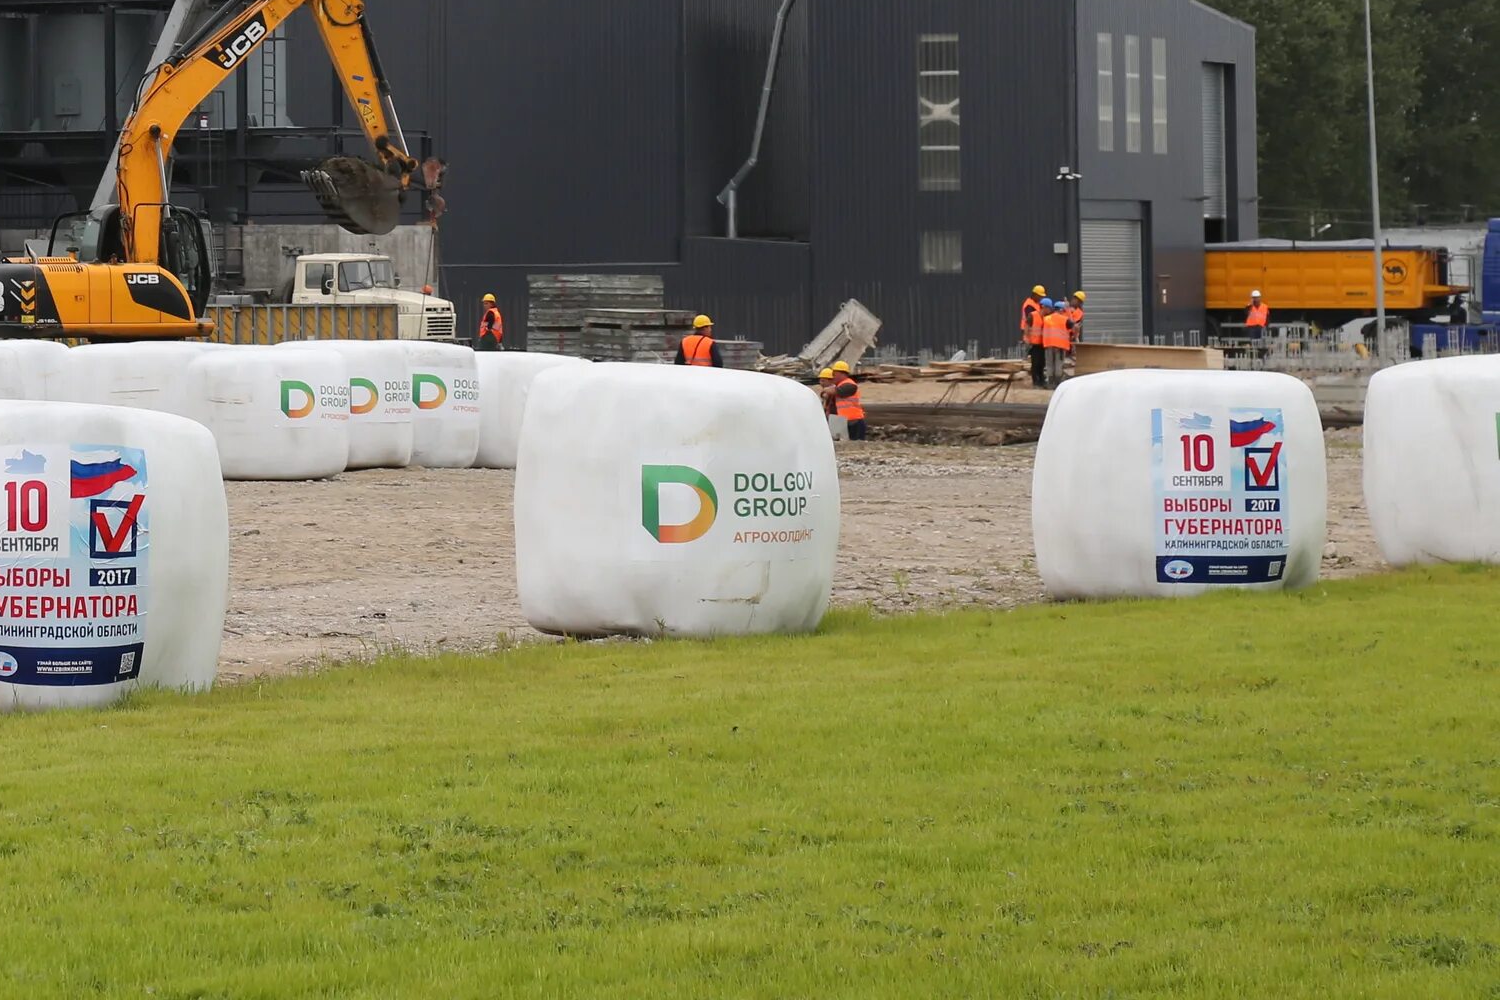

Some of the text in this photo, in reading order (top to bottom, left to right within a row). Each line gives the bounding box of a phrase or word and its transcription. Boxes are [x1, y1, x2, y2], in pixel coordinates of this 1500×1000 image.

[223, 20, 266, 68] JCB
[128, 274, 160, 284] JCB
[320, 397, 348, 408] GROUP
[384, 392, 409, 402] GROUP
[1180, 434, 1214, 472] 10
[734, 471, 813, 492] DOLGOV
[1172, 475, 1224, 487] СЕНТЯБРЯ
[4, 480, 48, 532] 10
[734, 497, 807, 517] GROUP
[1164, 499, 1232, 512] ВЫБОРЫ
[1251, 500, 1276, 511] 2017
[1165, 519, 1283, 535] ГУБЕРНАТОРА
[734, 529, 814, 544] АГРОХОЛДИНГ
[1165, 537, 1283, 551] КАЛИНИНГРАДСКОЙ ОБЛАСТИ
[97, 570, 131, 584] 2017
[97, 623, 138, 637] ОБЛАСТИ
